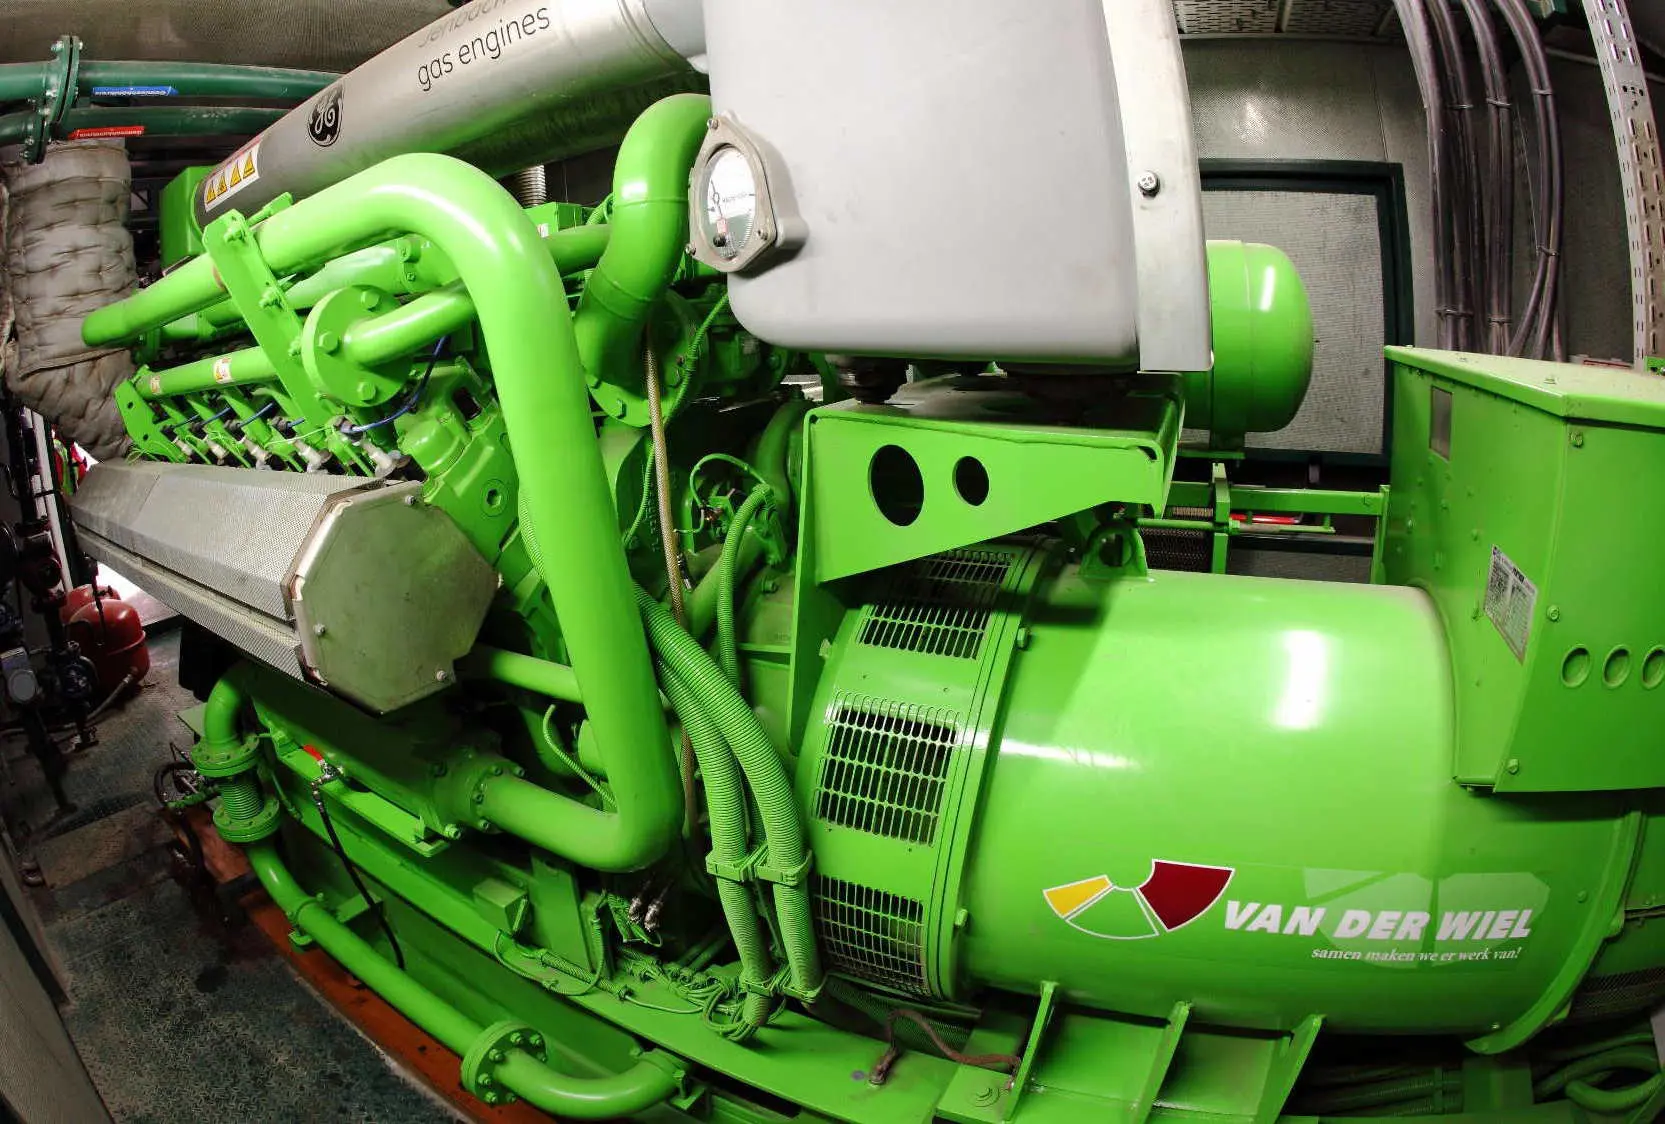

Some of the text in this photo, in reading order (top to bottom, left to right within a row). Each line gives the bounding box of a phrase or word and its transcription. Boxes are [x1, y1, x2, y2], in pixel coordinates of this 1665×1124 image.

[418, 7, 550, 92] gas engines
[1224, 900, 1533, 941] VAN DER WIEL
[1311, 946, 1522, 961] samen maken we er werk van!
